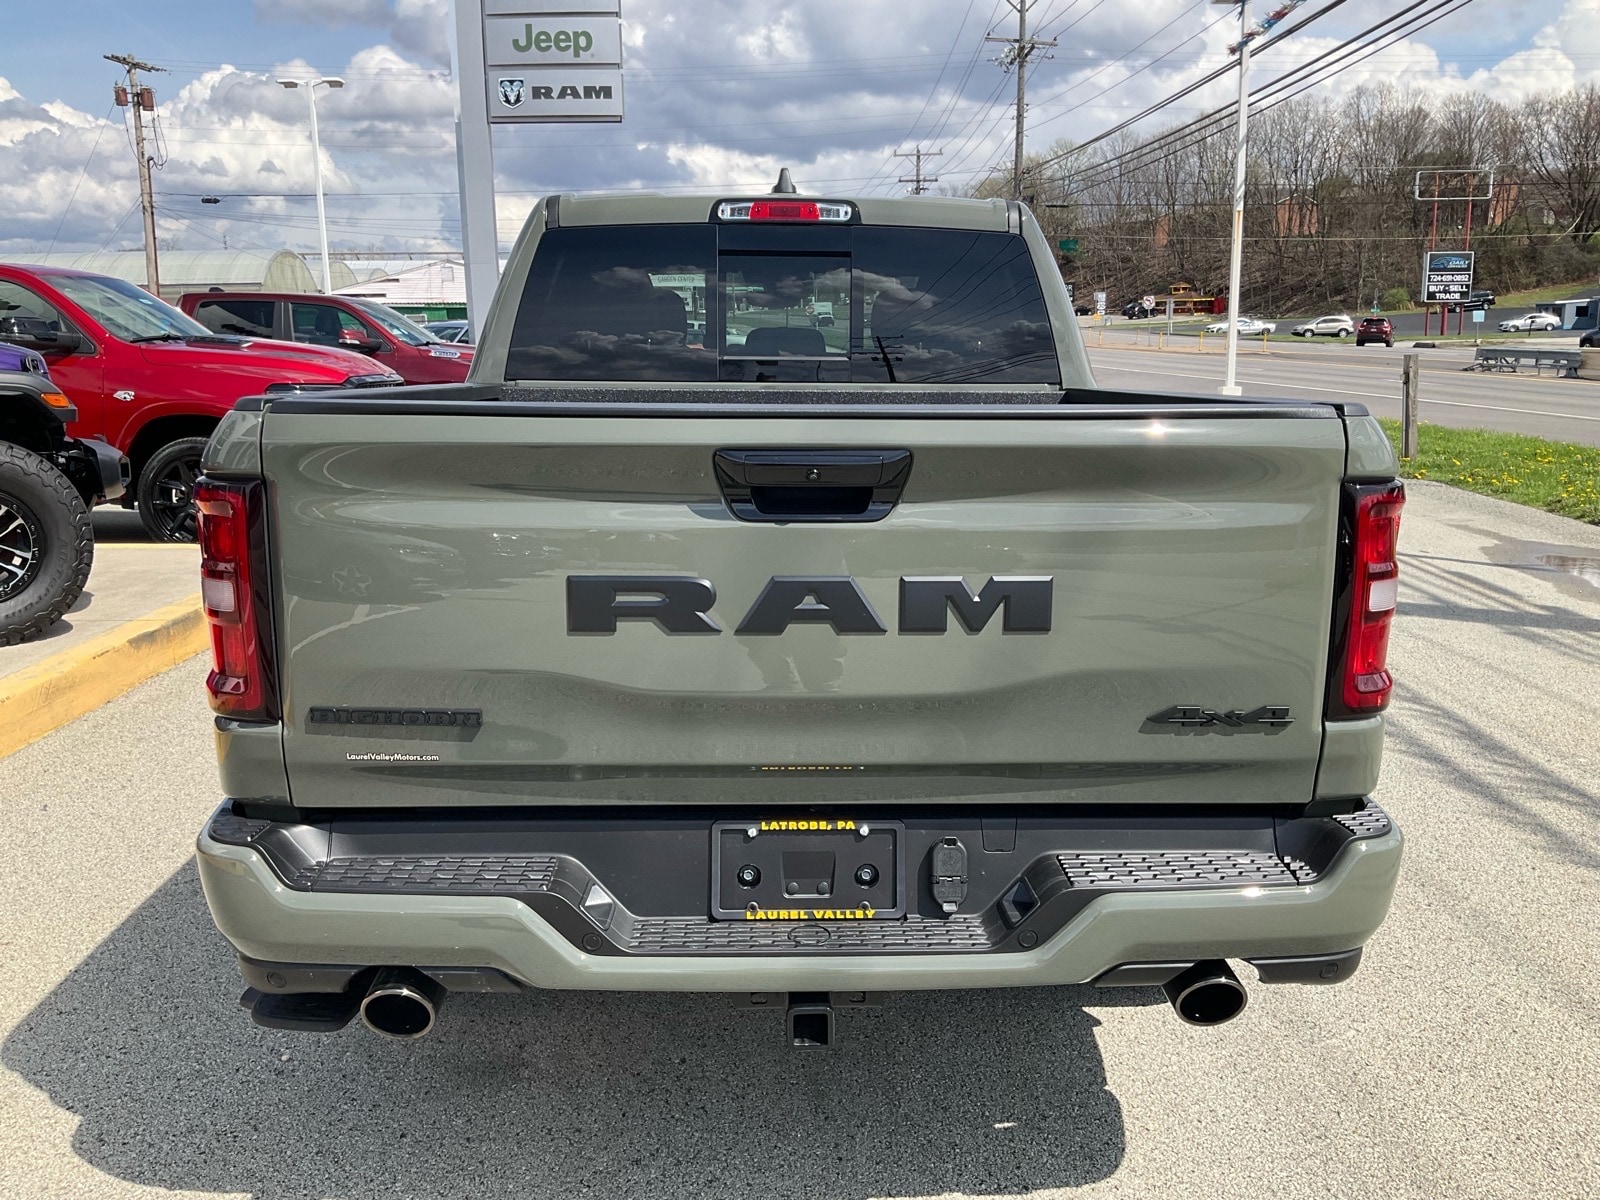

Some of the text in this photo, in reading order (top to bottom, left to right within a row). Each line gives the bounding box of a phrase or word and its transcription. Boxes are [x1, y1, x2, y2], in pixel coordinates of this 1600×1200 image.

[512, 23, 593, 58] Jeep
[531, 85, 613, 100] RAM
[566, 575, 1054, 636] RAM
[1145, 705, 1296, 727] 4x4
[346, 752, 439, 762] LaurelValleyMotors.com
[760, 821, 856, 831] LATROBE, PA
[746, 910, 876, 920] LAUREL VALLEY
